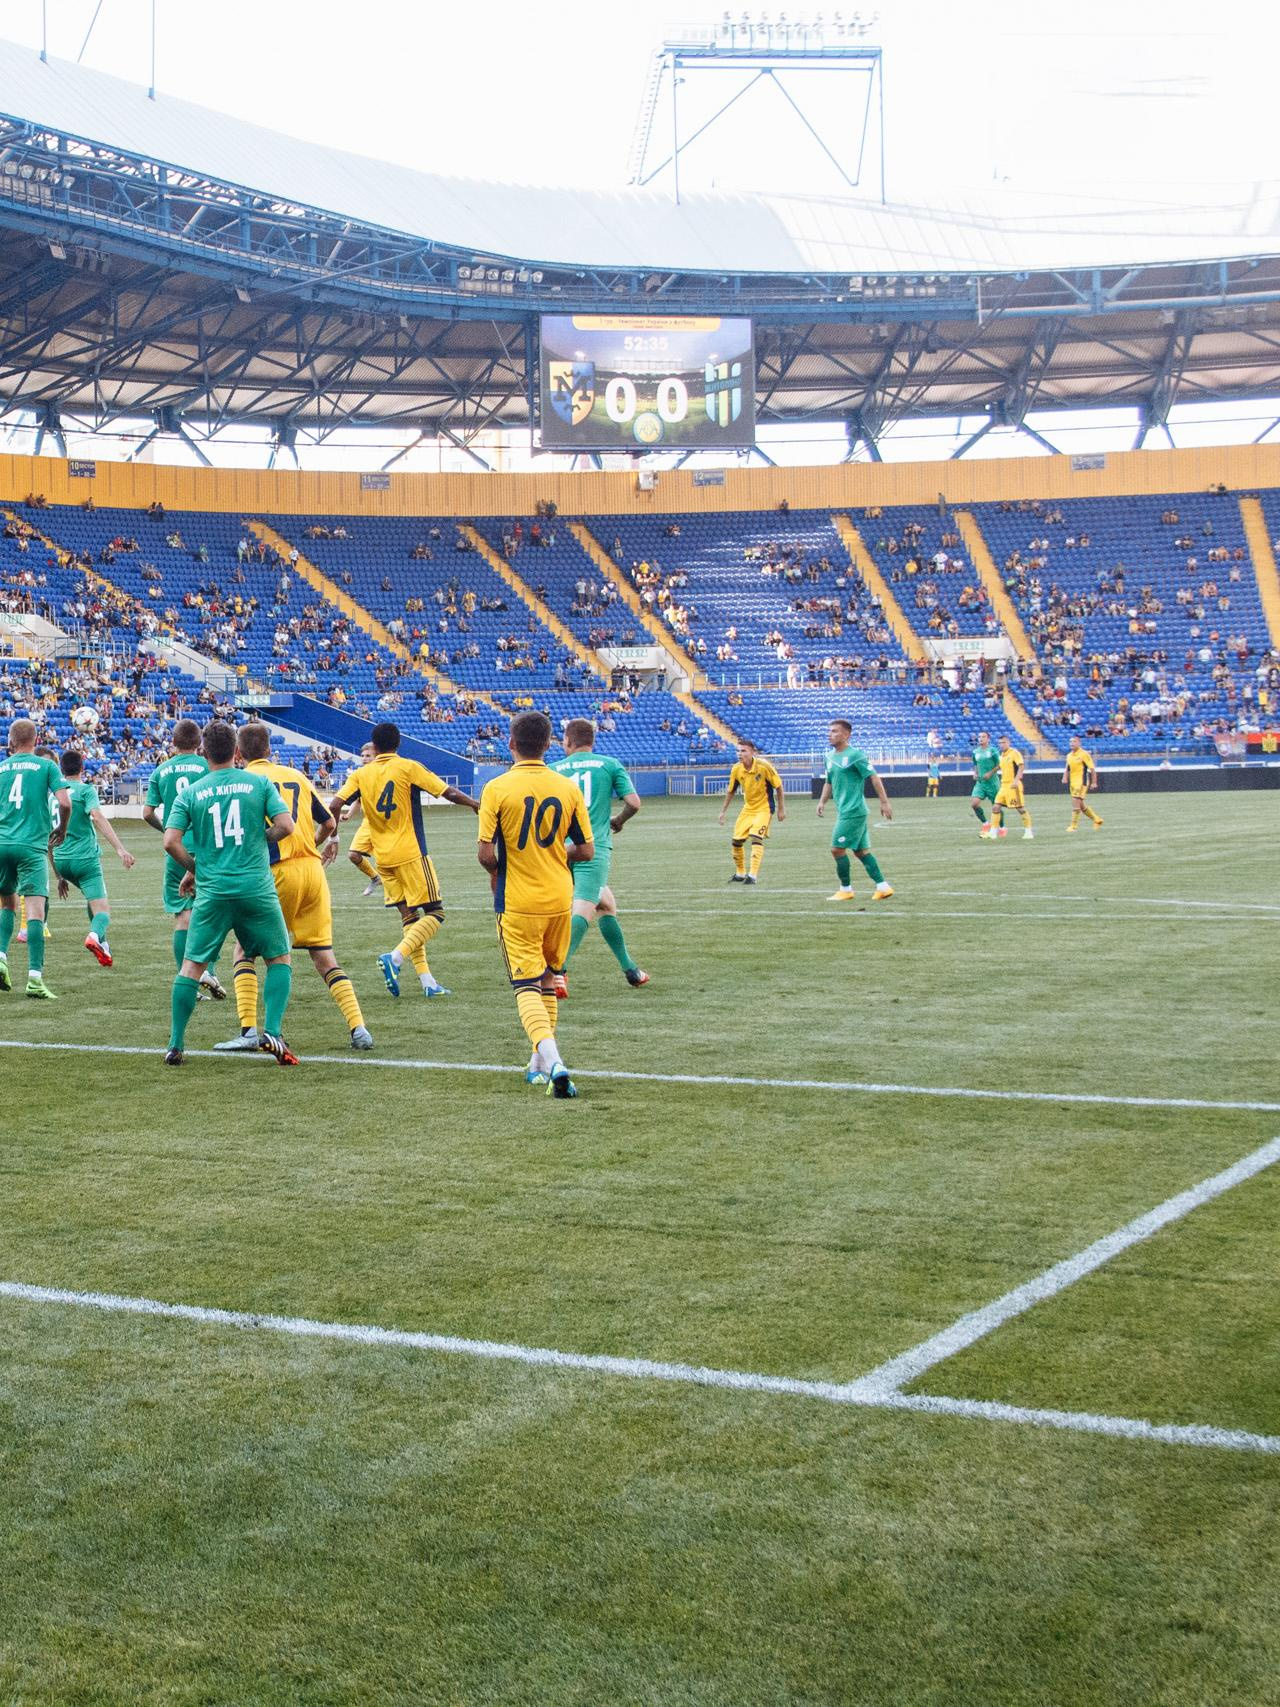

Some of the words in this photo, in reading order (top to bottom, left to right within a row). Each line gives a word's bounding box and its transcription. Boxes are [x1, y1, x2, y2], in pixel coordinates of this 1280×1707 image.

[624, 336, 668, 351] 52:35
[605, 377, 636, 423] 0
[656, 377, 688, 423] 0
[8, 773, 24, 810] 4
[195, 787, 214, 801] МФК
[216, 782, 254, 796] ЖИТОМИР
[376, 780, 398, 820] 4
[208, 798, 245, 849] 14
[517, 795, 563, 851] 10
